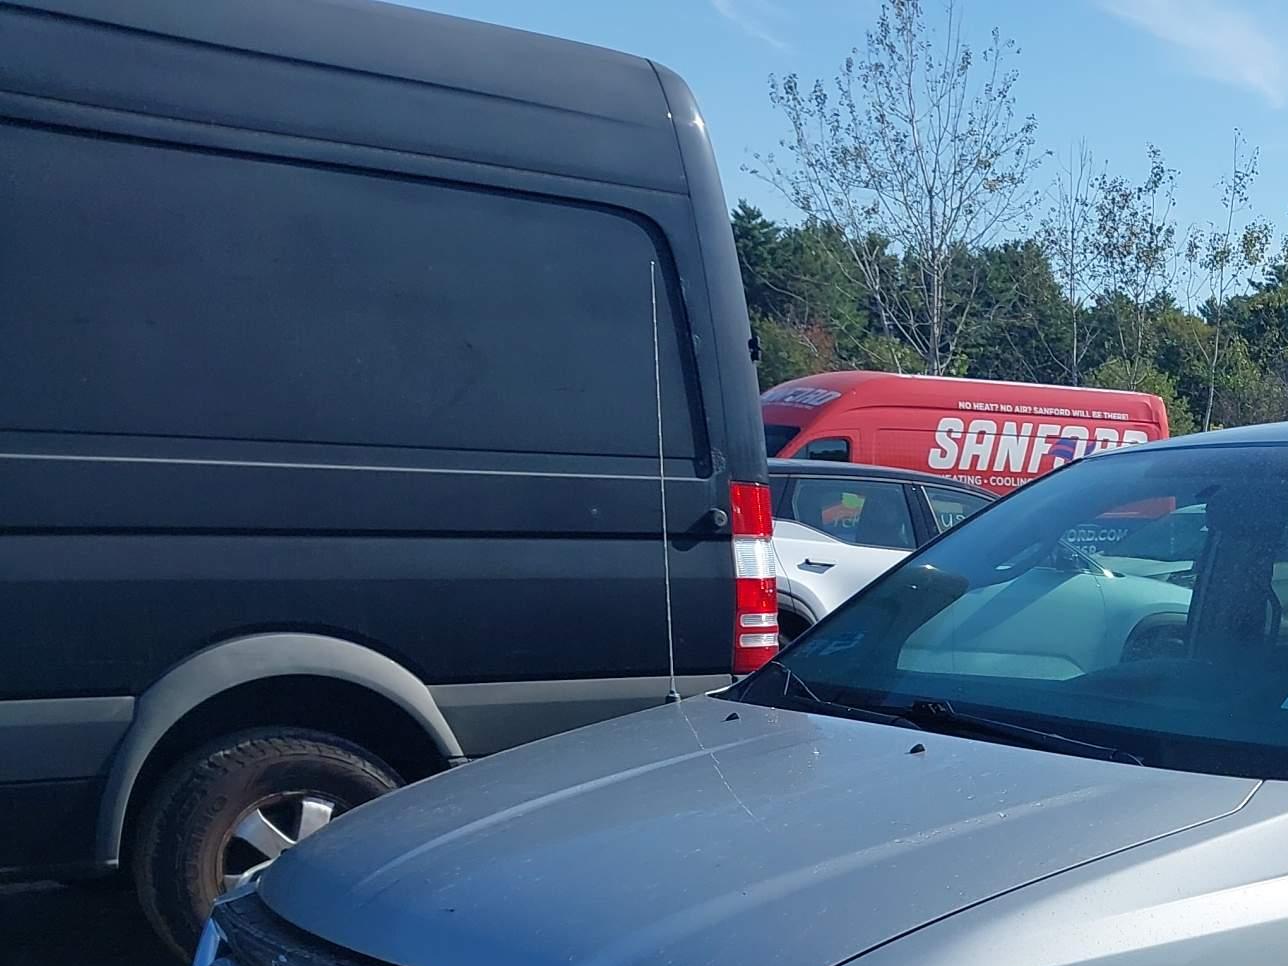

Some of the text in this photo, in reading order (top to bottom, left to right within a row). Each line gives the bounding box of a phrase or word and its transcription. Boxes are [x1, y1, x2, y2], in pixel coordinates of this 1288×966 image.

[958, 401, 972, 410] NO
[973, 402, 999, 411] HEAT?
[1000, 404, 1013, 412] NO
[1014, 405, 1032, 414] AIR?
[1033, 406, 1071, 417] SANFORD
[1071, 408, 1091, 418] WILL
[1092, 411, 1103, 419] BE
[928, 417, 1148, 473] SANFO
[1064, 527, 1129, 543] ORD.COM
